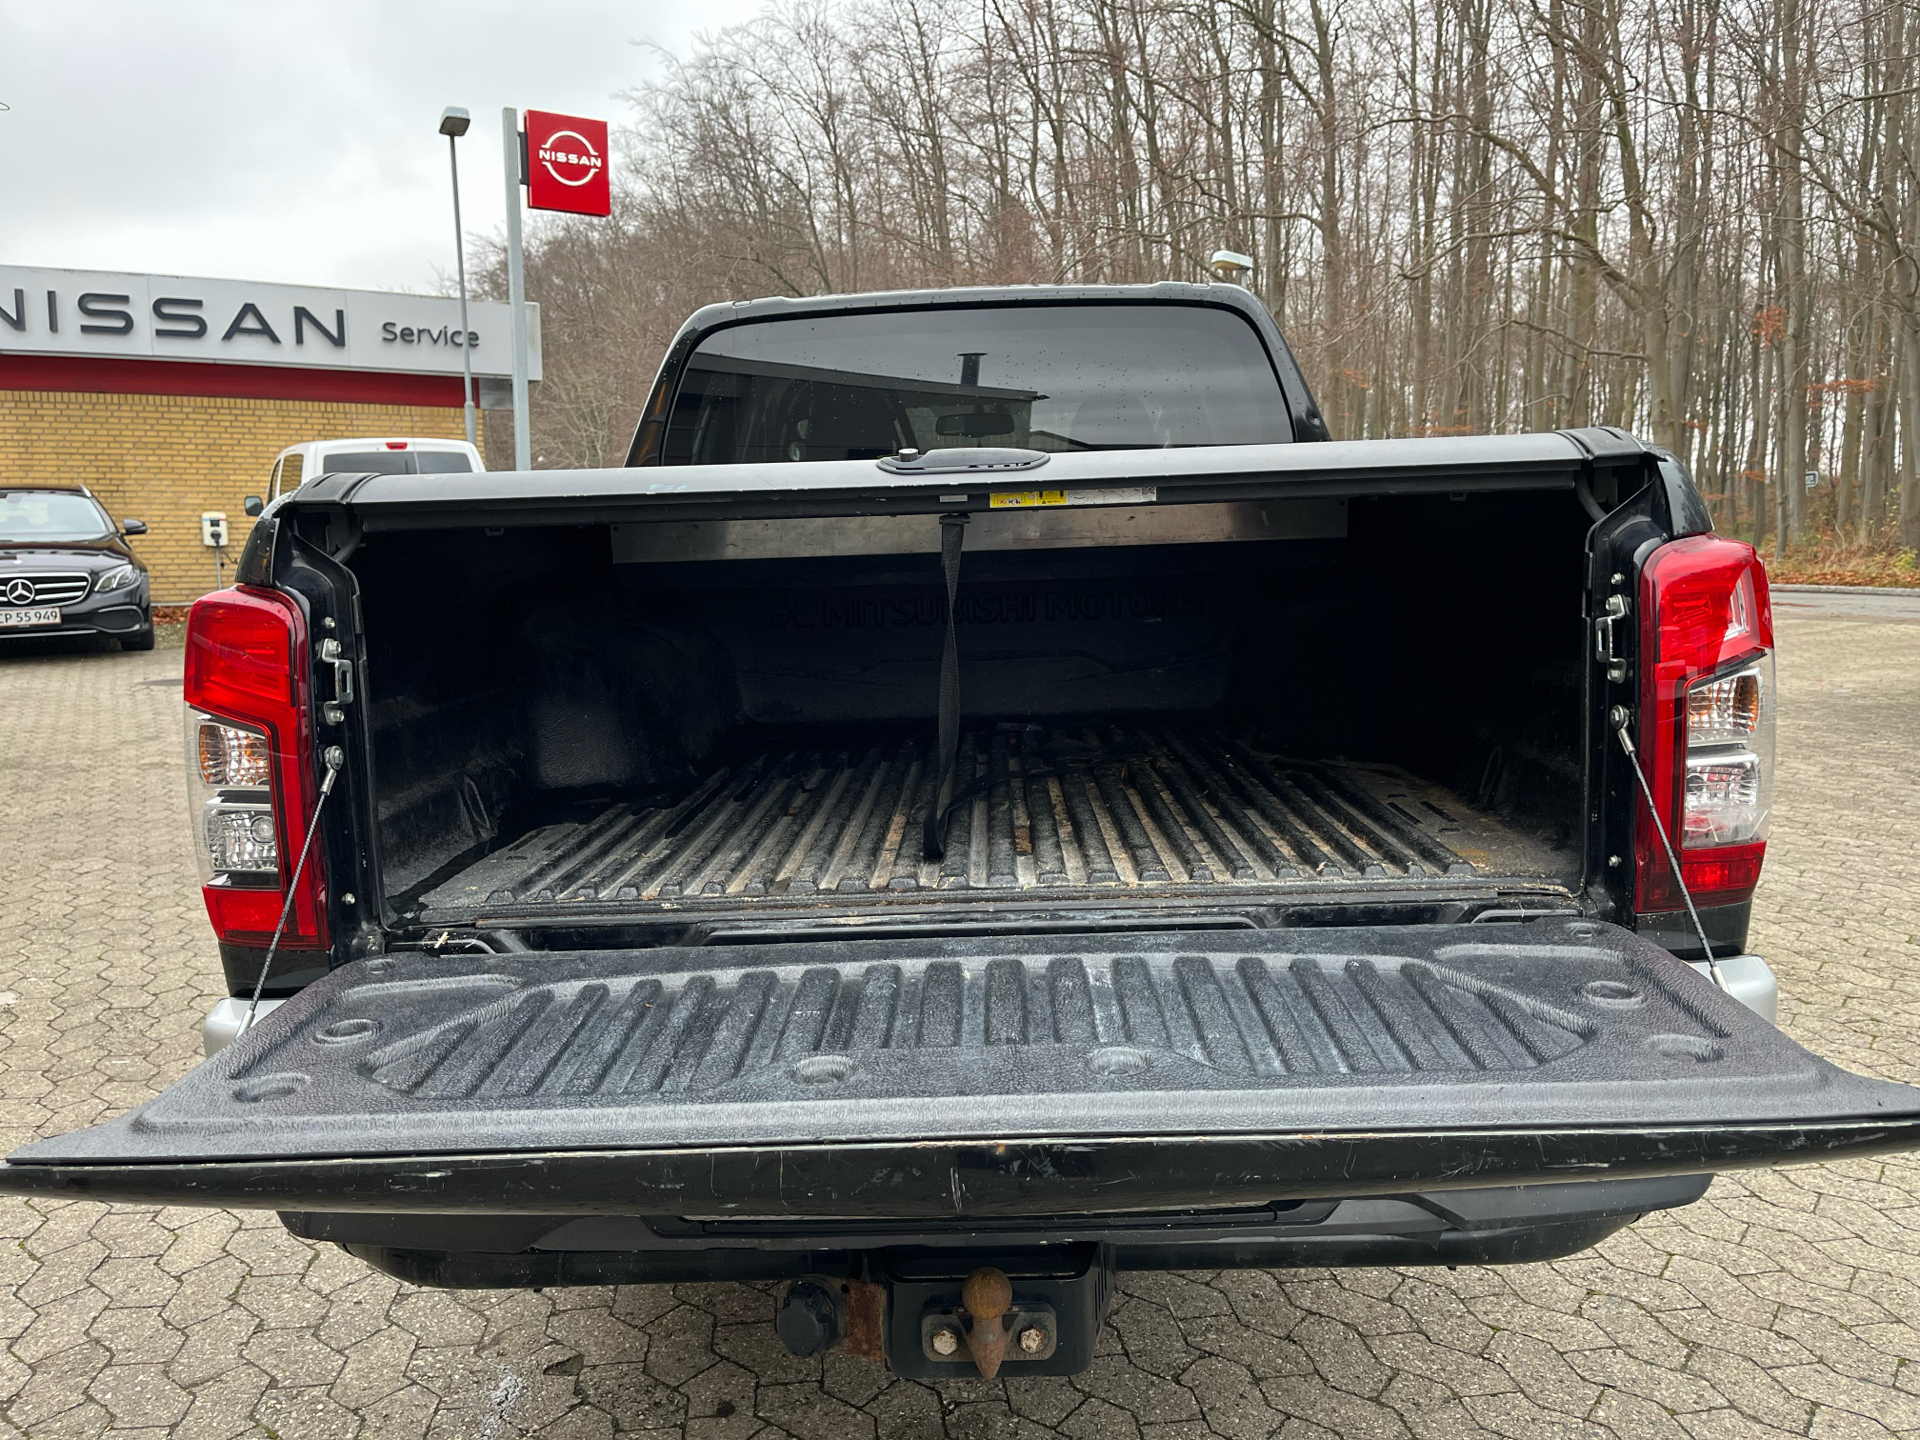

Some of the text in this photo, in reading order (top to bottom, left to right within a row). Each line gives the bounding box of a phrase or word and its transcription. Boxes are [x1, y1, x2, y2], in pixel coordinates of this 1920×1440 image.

[539, 149, 602, 168] NISSAN
[382, 322, 479, 347] Service
[16, 611, 31, 623] 55
[34, 610, 58, 622] 949
[822, 585, 1204, 628] MITSUBISHI MOTORS
